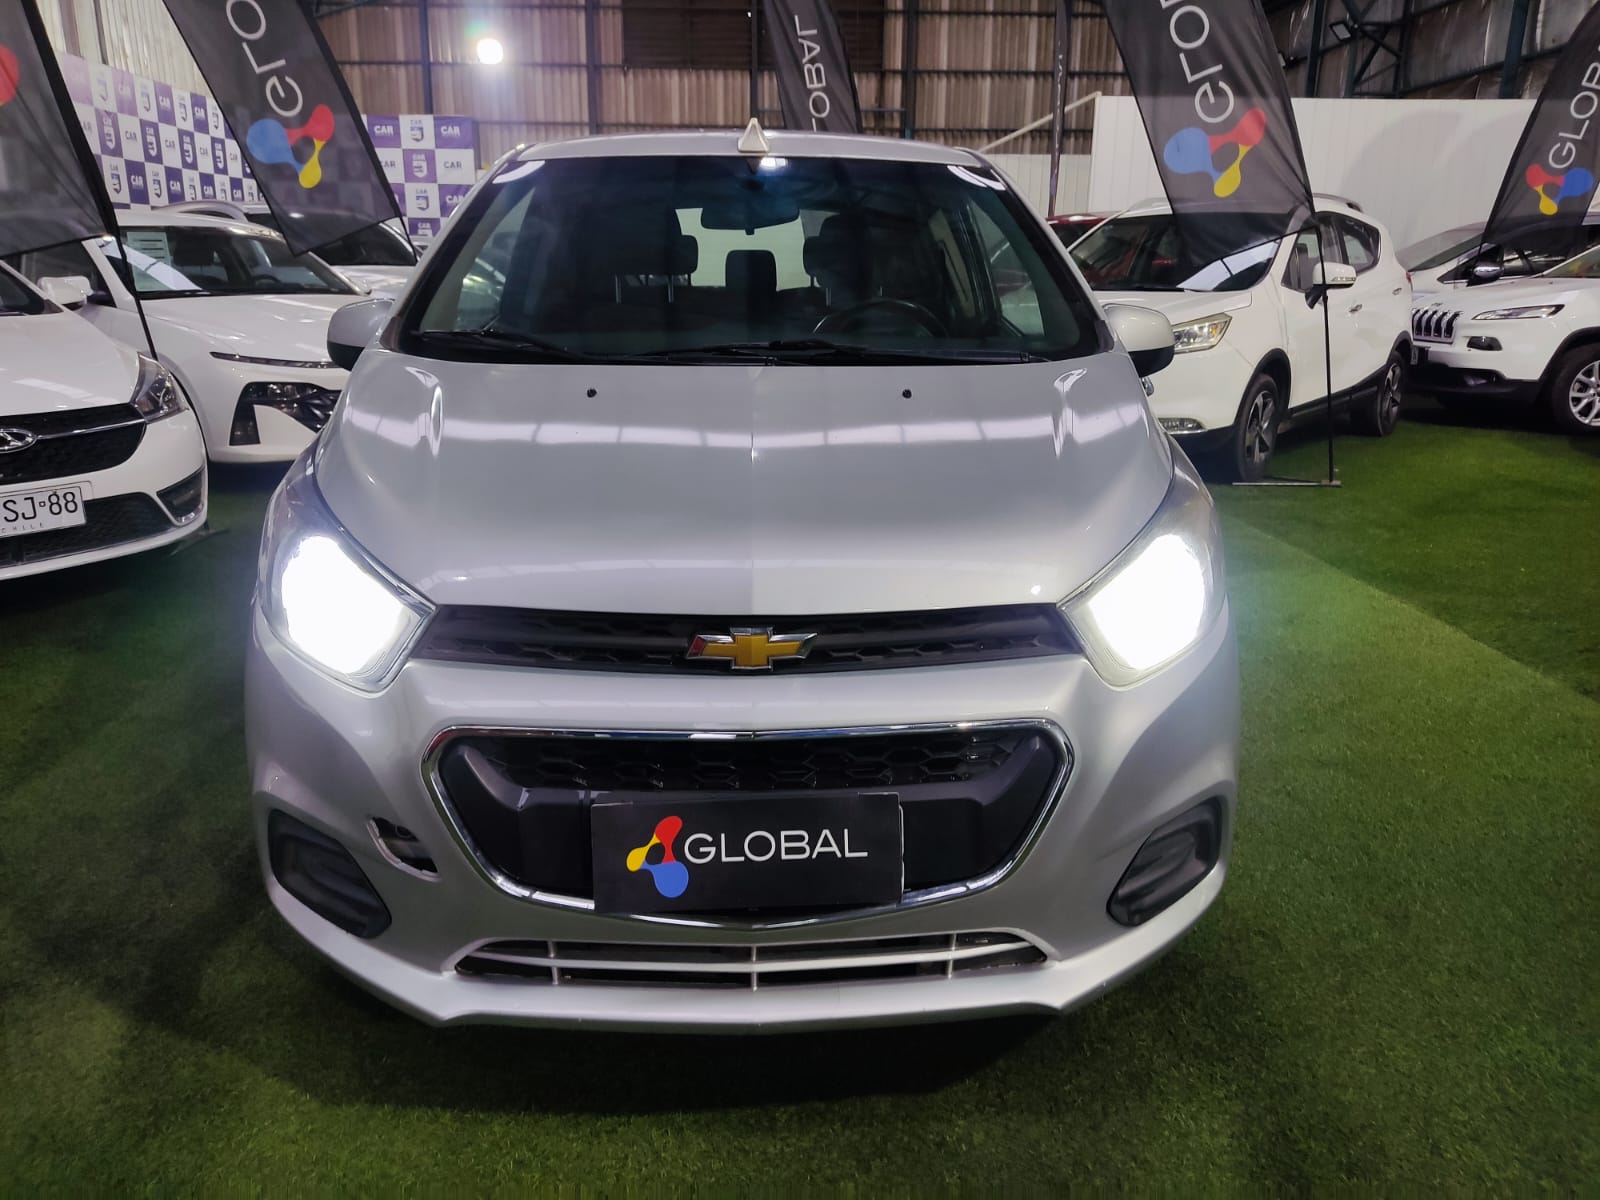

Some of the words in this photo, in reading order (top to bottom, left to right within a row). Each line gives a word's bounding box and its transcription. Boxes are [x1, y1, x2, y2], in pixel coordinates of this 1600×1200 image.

[1549, 45, 1600, 168] GLOB
[194, 107, 205, 118] CAR
[374, 125, 394, 135] CAR
[440, 126, 460, 136] CAR
[125, 130, 138, 142] CAR
[165, 139, 176, 150] CAR
[200, 146, 209, 156] CAR
[443, 160, 462, 169] CAR
[130, 174, 144, 187] CAR
[169, 180, 181, 191] CAR
[203, 186, 214, 195] CAR
[684, 828, 868, 864] GLOBAL
